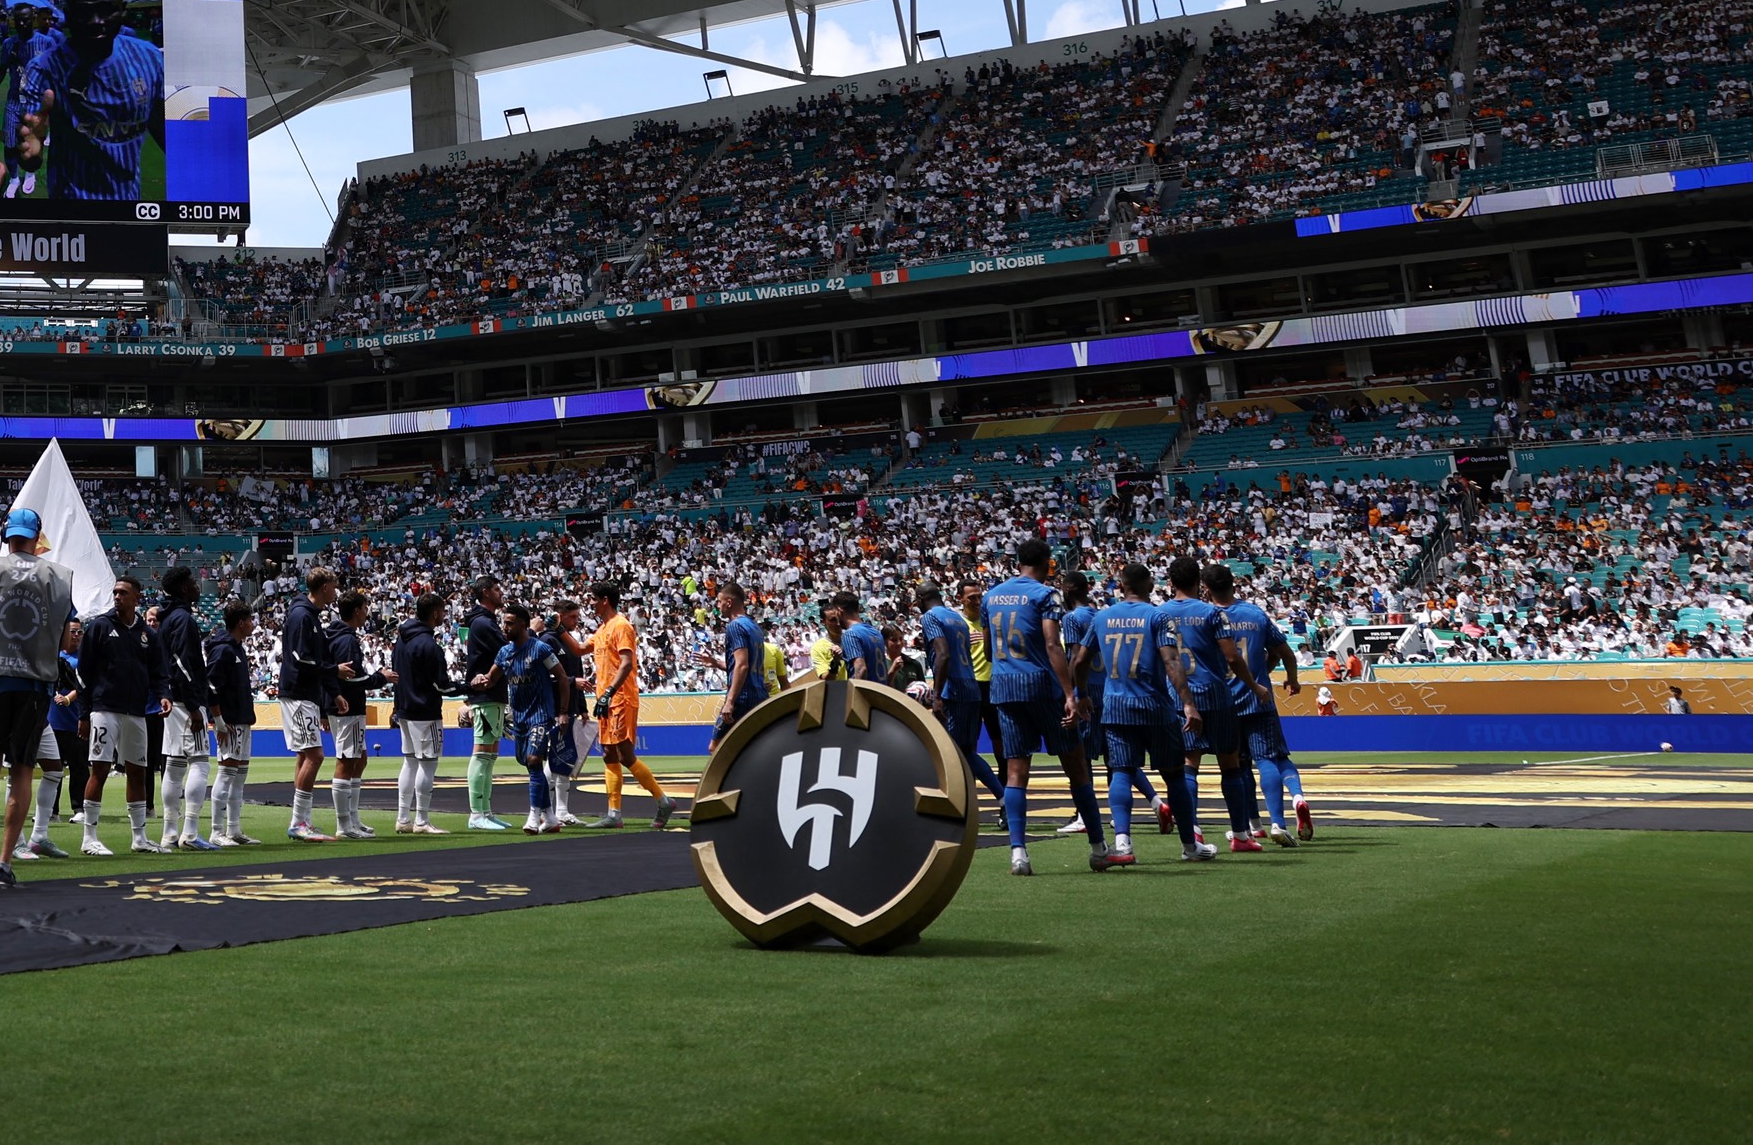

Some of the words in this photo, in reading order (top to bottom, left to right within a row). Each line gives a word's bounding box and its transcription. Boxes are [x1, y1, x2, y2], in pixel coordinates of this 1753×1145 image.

[1063, 42, 1088, 57] 316
[837, 82, 859, 95] 315
[447, 150, 467, 164] 313
[138, 205, 159, 219] CC
[178, 204, 213, 219] 3:00
[218, 205, 241, 220] PM
[10, 232, 86, 263] World
[968, 259, 994, 275] JOE
[995, 253, 1046, 270] ROBBIE
[720, 289, 753, 305] PAUL
[754, 282, 821, 301] WARFIELD
[825, 277, 846, 292] 42
[532, 314, 554, 329] JIM
[556, 308, 606, 326] LANGER
[615, 303, 635, 318] 62
[356, 336, 380, 350] BOB
[382, 331, 421, 347] GRIESE
[423, 327, 437, 342] 12
[116, 343, 156, 357] LARRY
[161, 343, 214, 358] CSONKA
[218, 344, 236, 358] 39
[1654, 362, 1734, 381] WORLD
[1434, 458, 1446, 468] 117
[1520, 452, 1535, 463] 118
[873, 498, 884, 508] 116
[11, 569, 37, 583] 276
[7, 588, 42, 604] WORLD
[1107, 617, 1146, 629] MALCOM
[991, 611, 1026, 660] 16
[1104, 632, 1145, 679] 77
[93, 726, 108, 745] 12
[1466, 723, 1527, 745] FIFA
[1533, 723, 1610, 745] CLUB
[1616, 723, 1733, 745] WORLD
